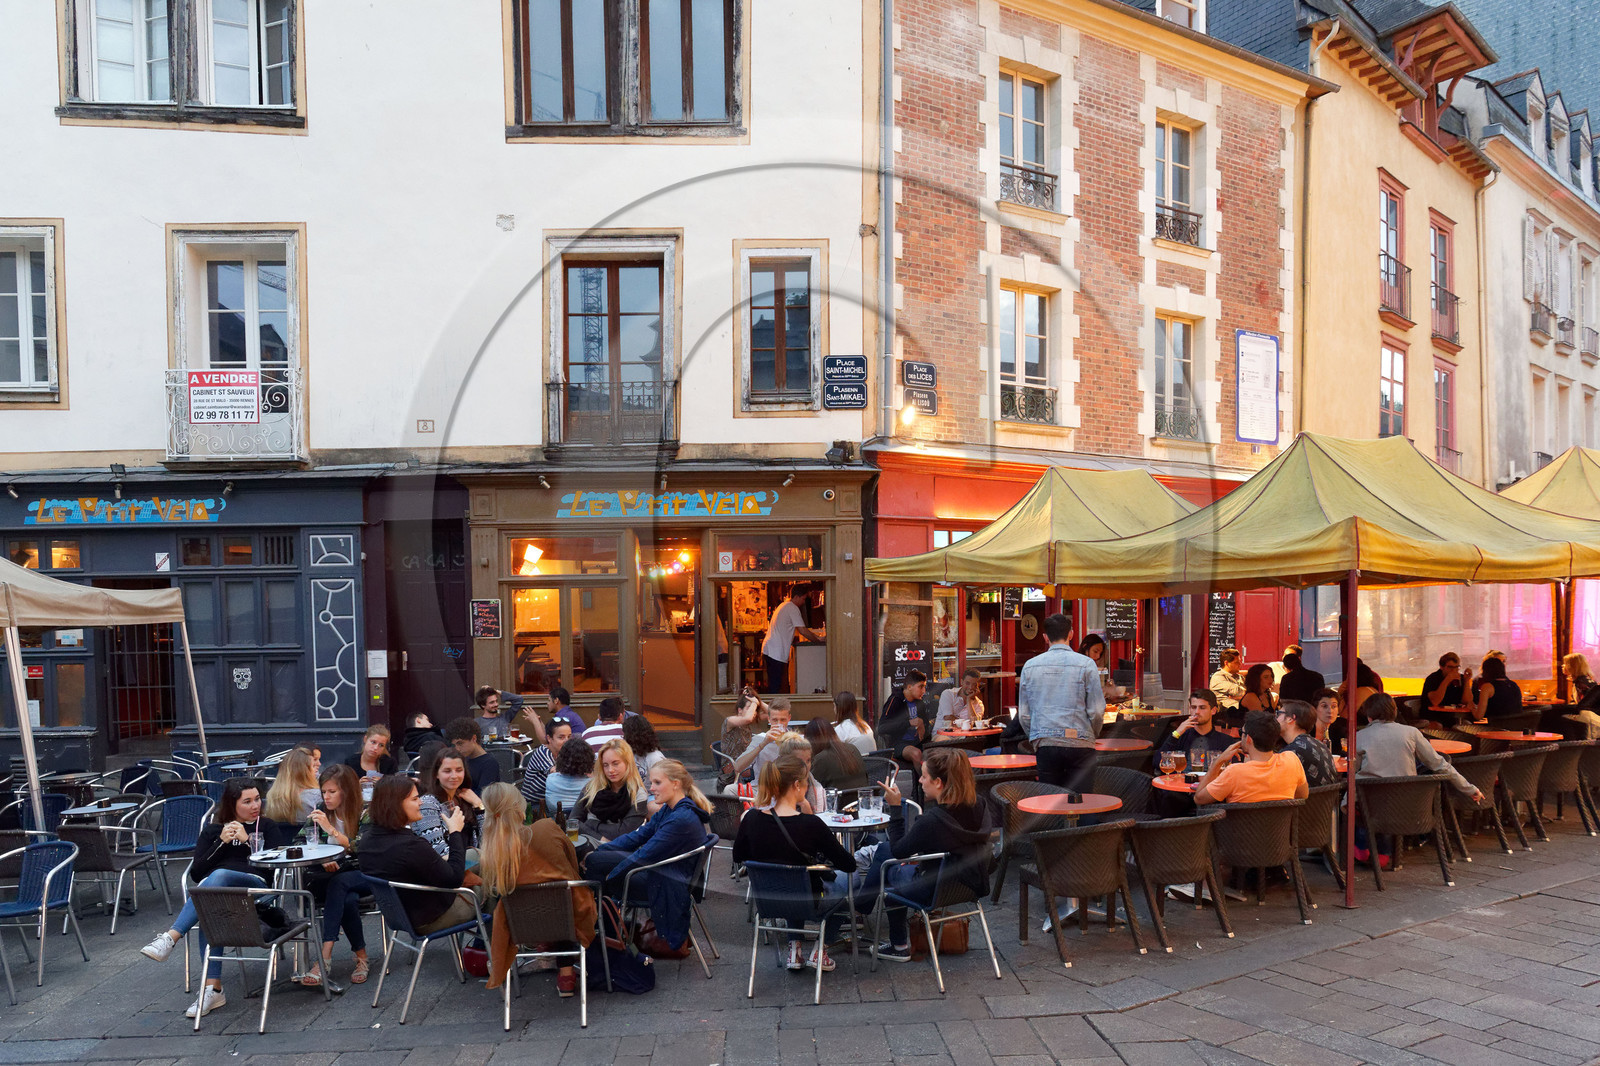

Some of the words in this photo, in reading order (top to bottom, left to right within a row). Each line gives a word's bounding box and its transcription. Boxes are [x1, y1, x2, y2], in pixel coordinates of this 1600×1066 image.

[826, 366, 865, 374] SAINT-MICHEL
[190, 374, 200, 384] A
[203, 374, 257, 384] VENDRE
[916, 372, 933, 382] LICES
[218, 388, 226, 396] ST
[226, 388, 255, 396] SAUVEUR
[826, 393, 865, 401] SANT-MIKAEL
[194, 411, 204, 420] 02
[206, 411, 217, 420] 99
[219, 410, 229, 419] 78
[231, 410, 241, 419] 11
[244, 410, 255, 419] 77
[895, 648, 926, 661] SCOOP
